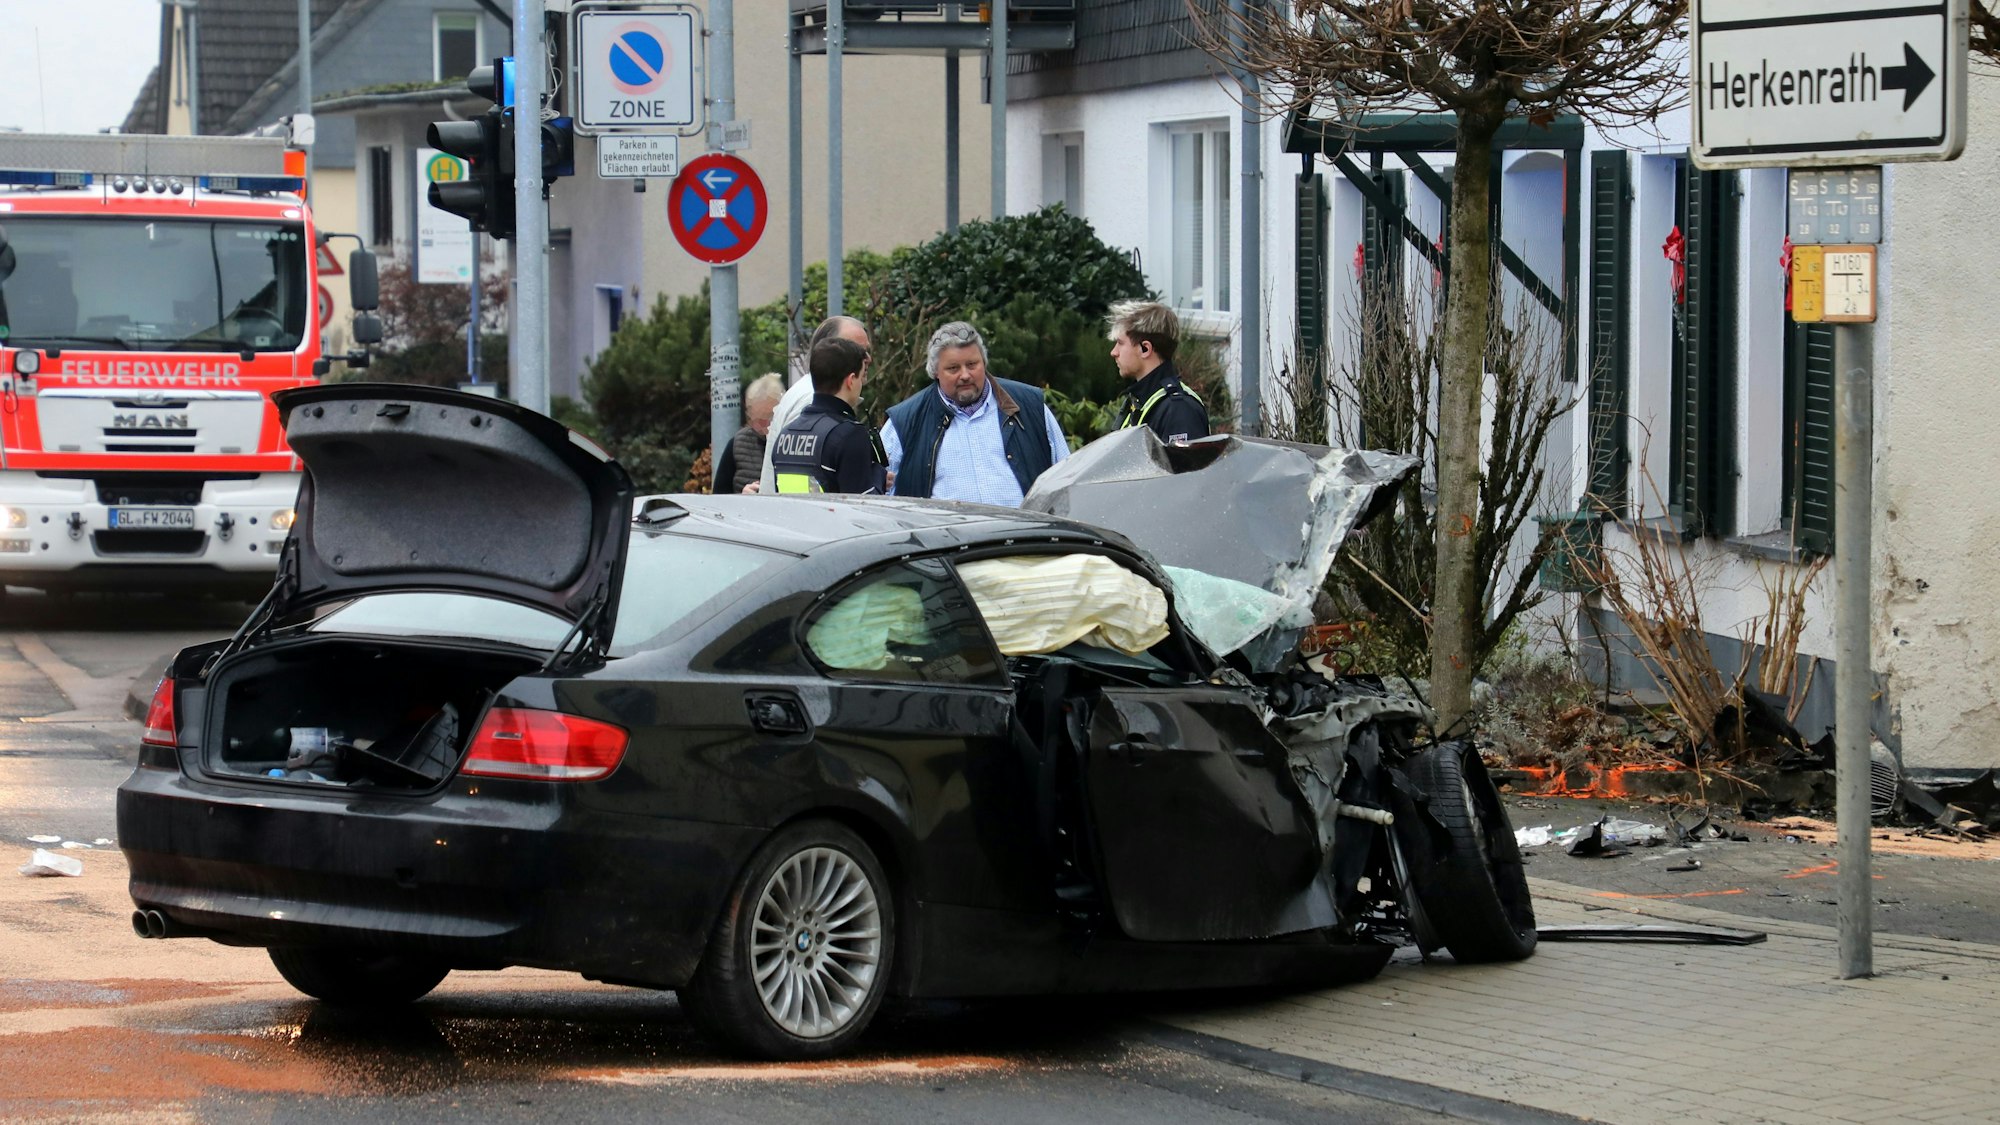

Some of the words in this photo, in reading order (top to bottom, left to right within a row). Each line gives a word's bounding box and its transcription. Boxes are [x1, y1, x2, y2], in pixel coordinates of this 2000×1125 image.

[1709, 52, 1877, 110] Herkenrath
[609, 100, 666, 118] ZONE
[619, 140, 647, 149] Parken
[650, 140, 658, 149] in
[603, 152, 674, 163] gekennzeichneten
[437, 160, 453, 181] H
[607, 163, 638, 173] Flächen
[641, 163, 670, 172] erlaubt
[1790, 179, 1799, 195] S
[1819, 179, 1828, 194] S
[1849, 177, 1859, 194] S
[145, 223, 154, 240] 1
[61, 360, 241, 386] FEUERWEHR
[113, 414, 188, 428] MAN
[776, 433, 818, 456] POLIZEI
[118, 512, 134, 525] GL
[143, 512, 158, 524] FW
[162, 512, 192, 525] 2044
